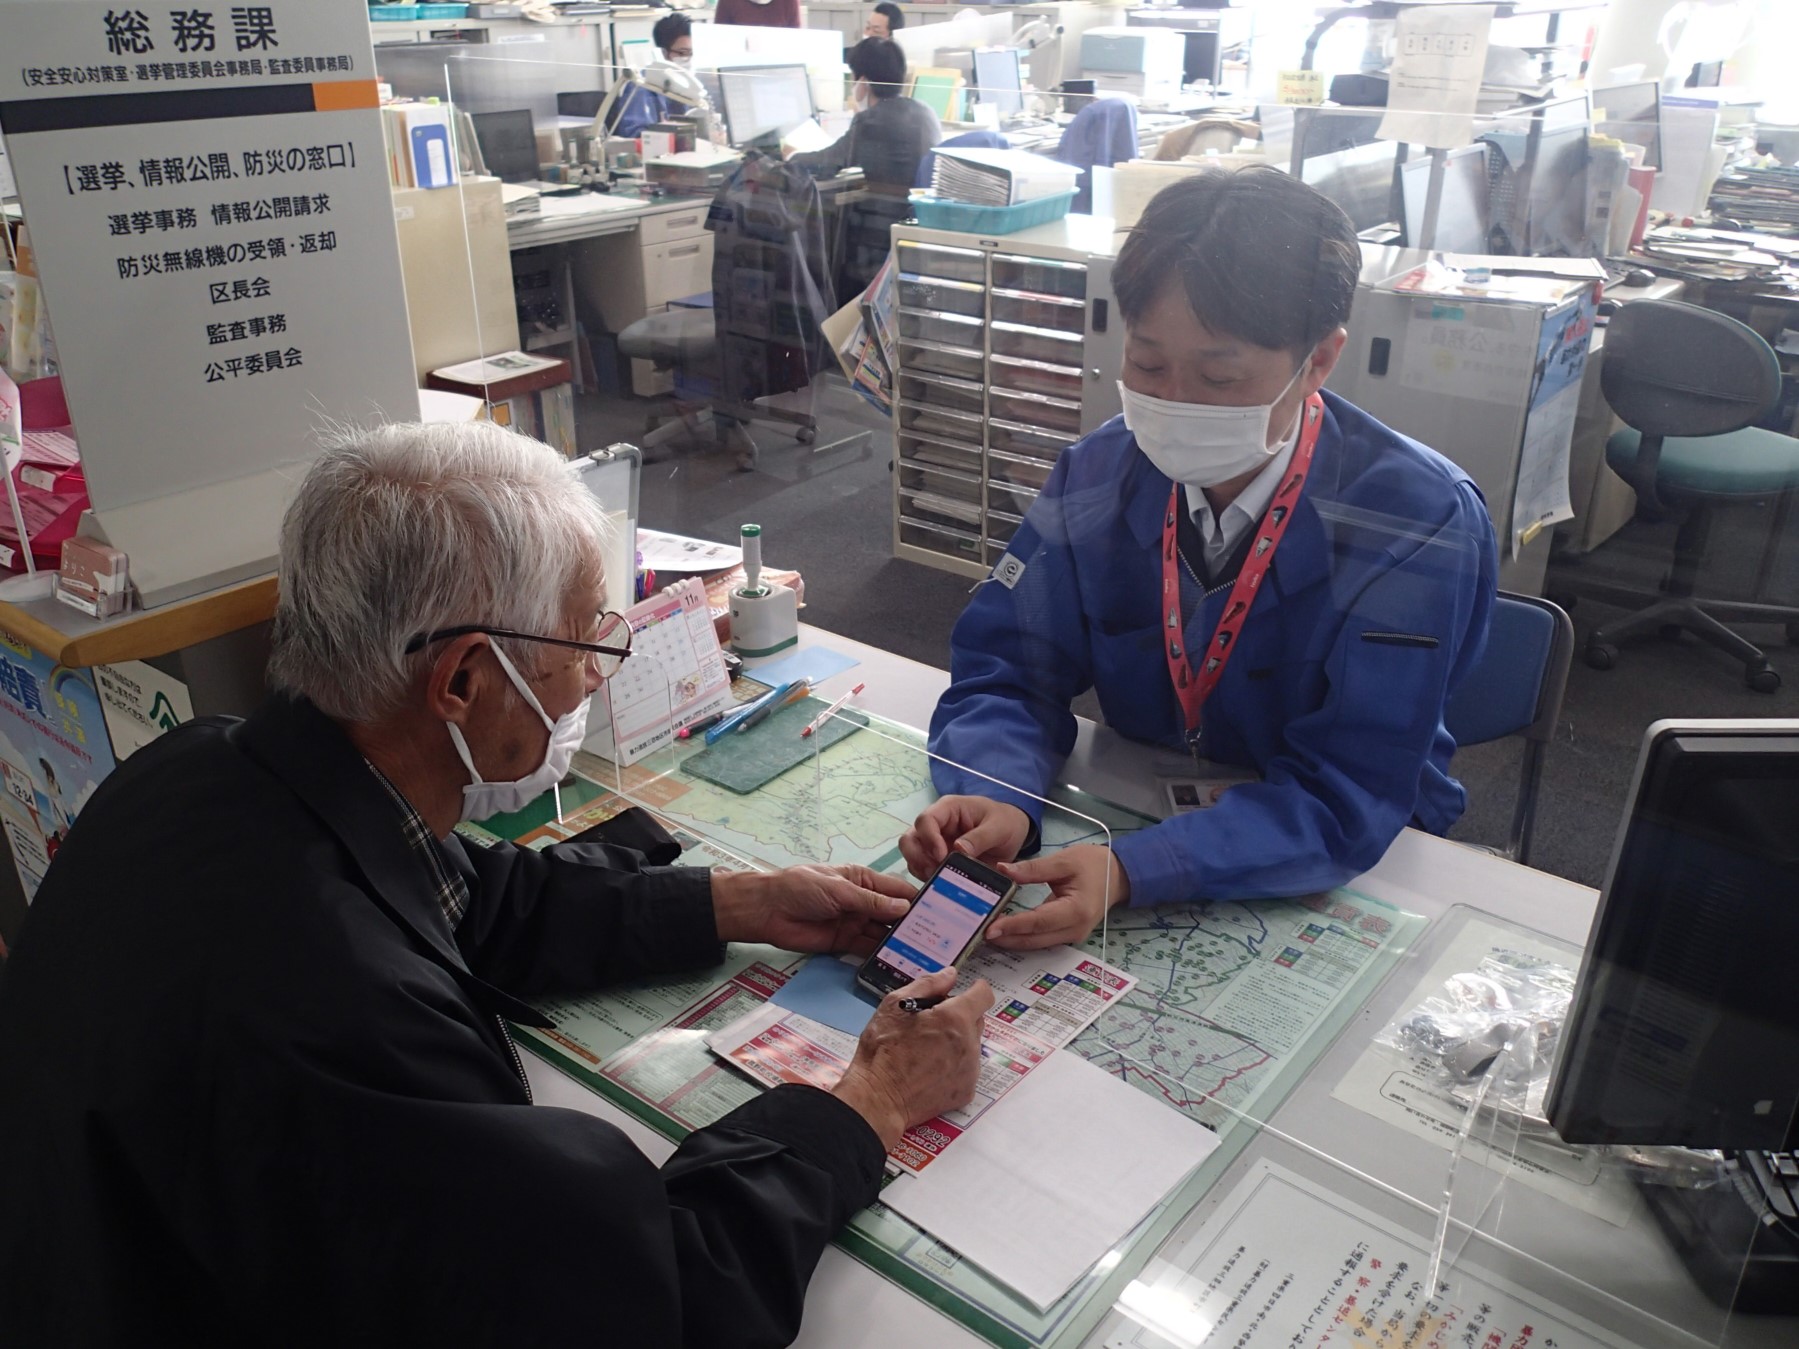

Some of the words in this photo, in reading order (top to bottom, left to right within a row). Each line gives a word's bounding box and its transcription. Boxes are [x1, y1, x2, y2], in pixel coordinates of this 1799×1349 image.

[104, 7, 280, 56] 総務課
[63, 141, 356, 195] 【選挙、情報公開、防災の窓口】
[107, 206, 198, 237] 選挙事務
[211, 193, 331, 226] 情報公開請求
[116, 231, 337, 280] 防災無線機の受領・返却
[209, 276, 271, 305] 区長会
[206, 313, 287, 345] 監査事務
[204, 346, 303, 383] 公平委員会
[1353, 1261, 1409, 1338] 要求を受けた場合
